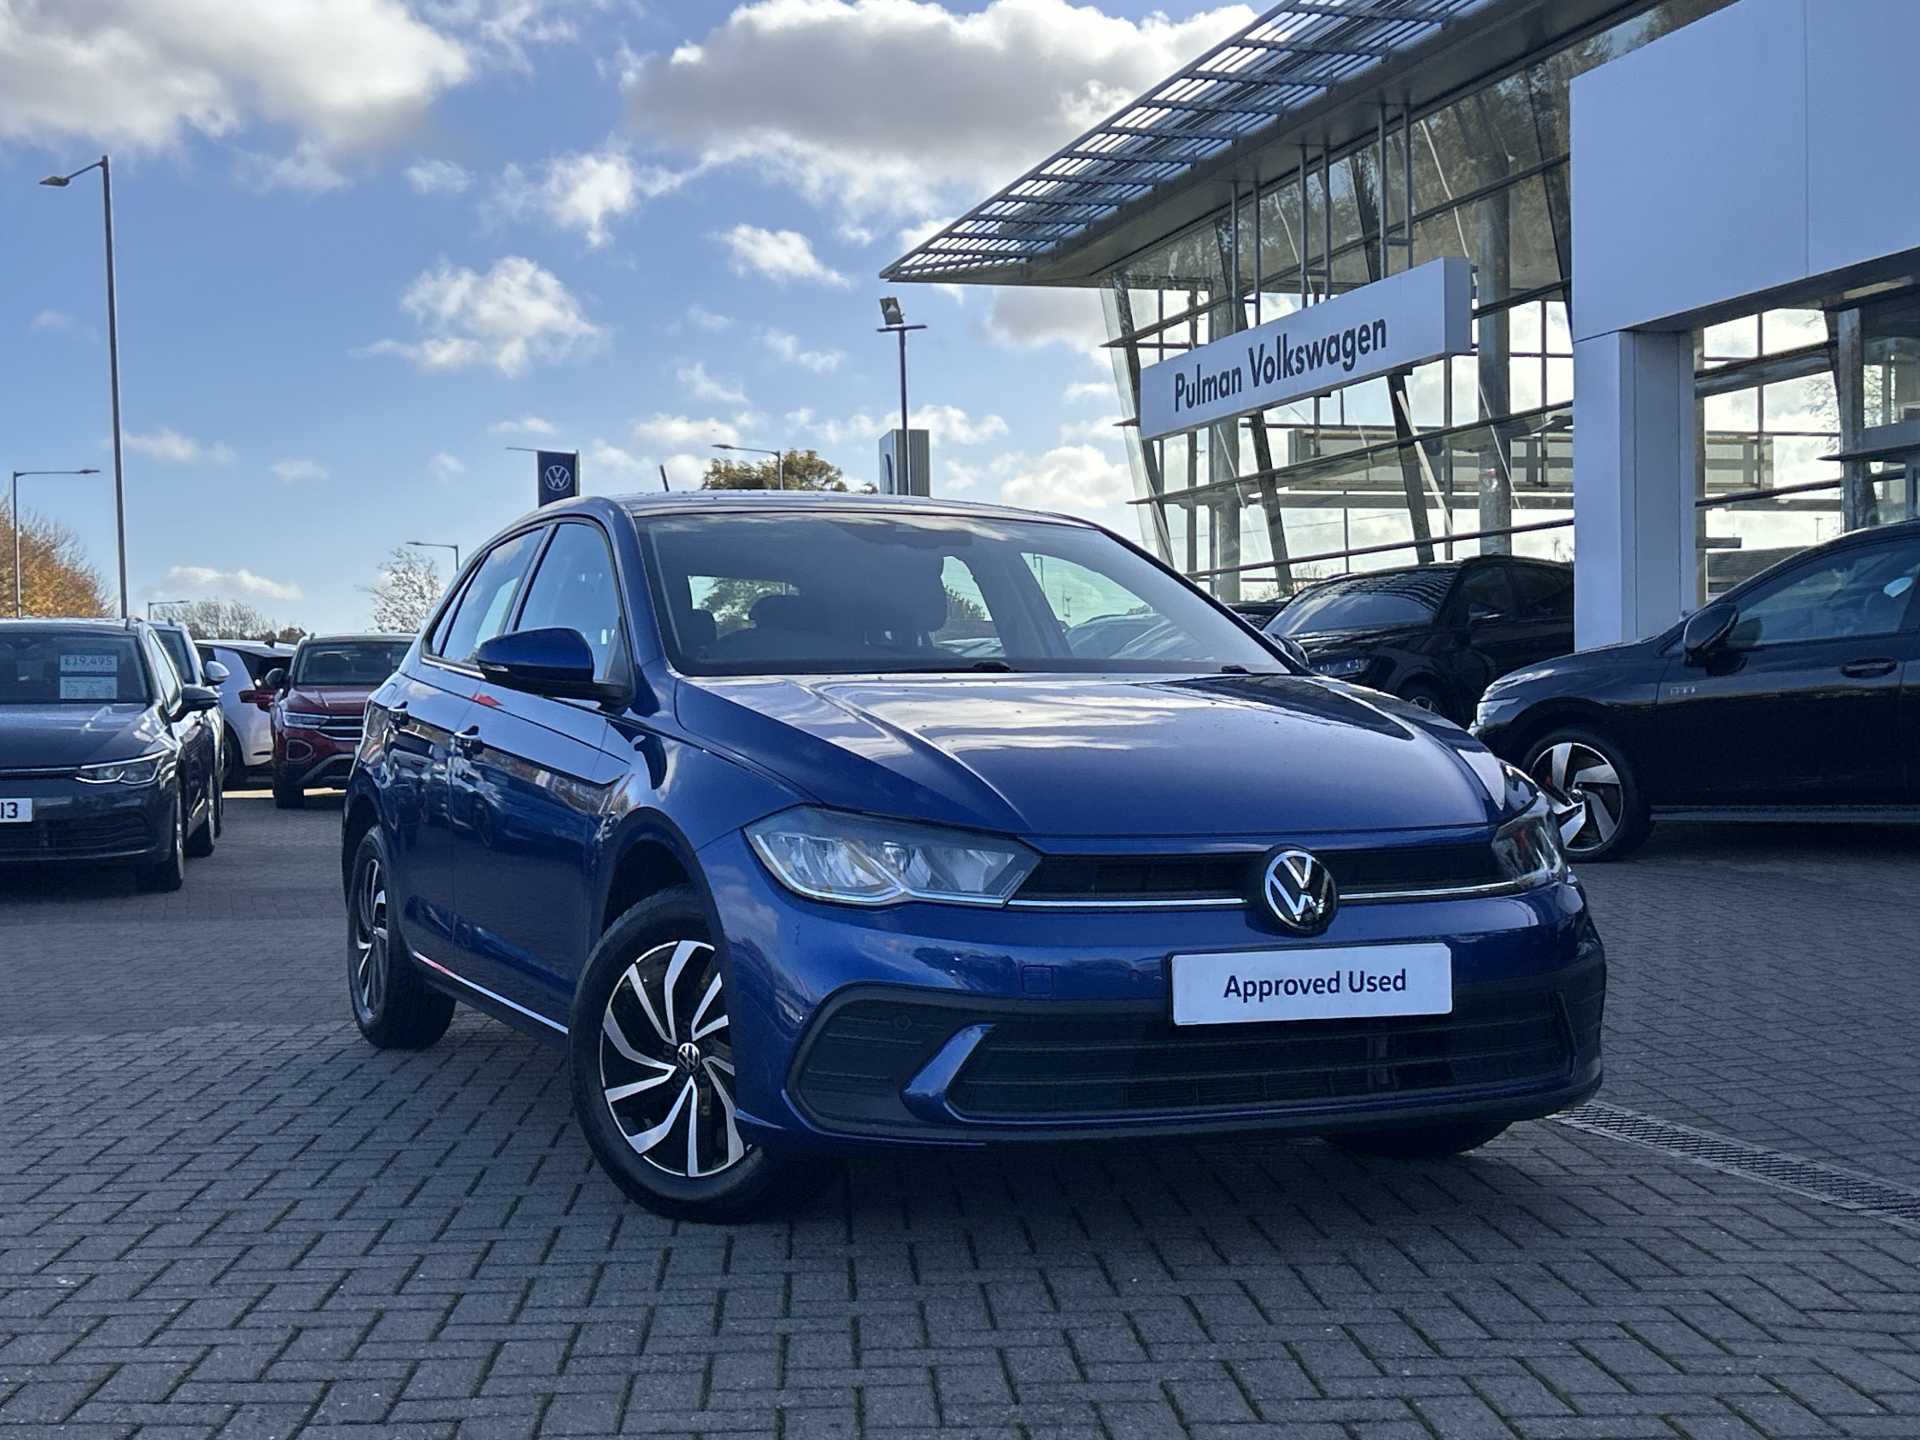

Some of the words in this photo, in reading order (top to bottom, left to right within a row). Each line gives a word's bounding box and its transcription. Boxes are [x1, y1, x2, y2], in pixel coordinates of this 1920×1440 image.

[1174, 363, 1243, 413] Pulman
[1247, 317, 1388, 388] Volkswagen
[1223, 970, 1341, 1003] Approved
[1348, 967, 1408, 994] Used
